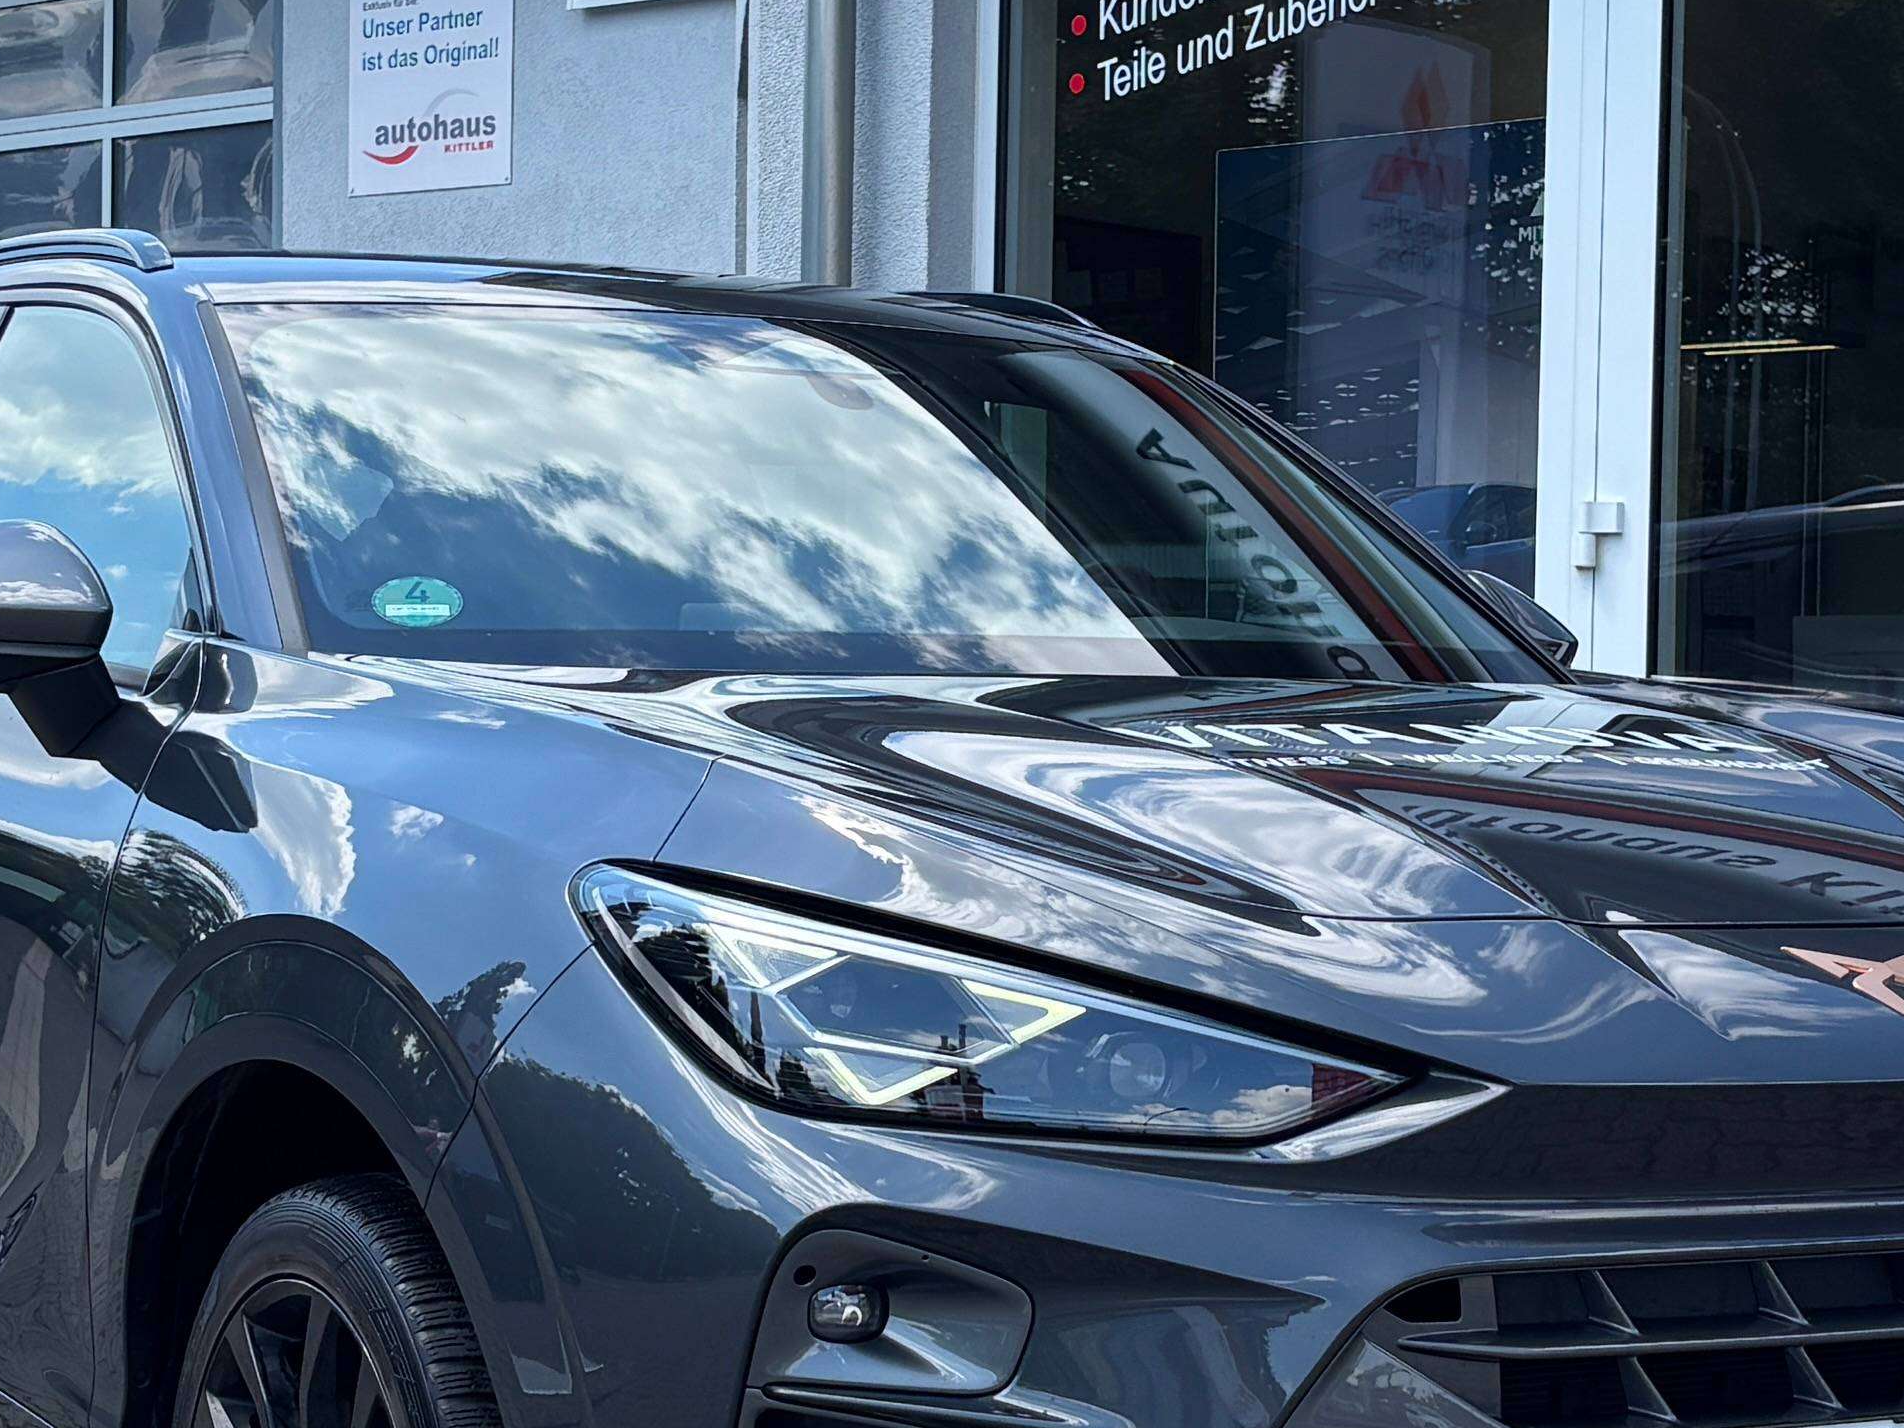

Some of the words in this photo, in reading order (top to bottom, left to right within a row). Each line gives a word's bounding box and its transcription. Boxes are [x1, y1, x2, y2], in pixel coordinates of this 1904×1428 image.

[362, 18, 414, 39] Unser
[418, 9, 484, 33] Partner
[362, 52, 383, 71] ist
[388, 49, 419, 69] das
[424, 37, 500, 67] Original!
[1098, 47, 1166, 101] Teile
[1176, 15, 1233, 75] und
[374, 114, 497, 146] autohaus
[404, 581, 431, 603] 4
[1101, 723, 1435, 748] VITA
